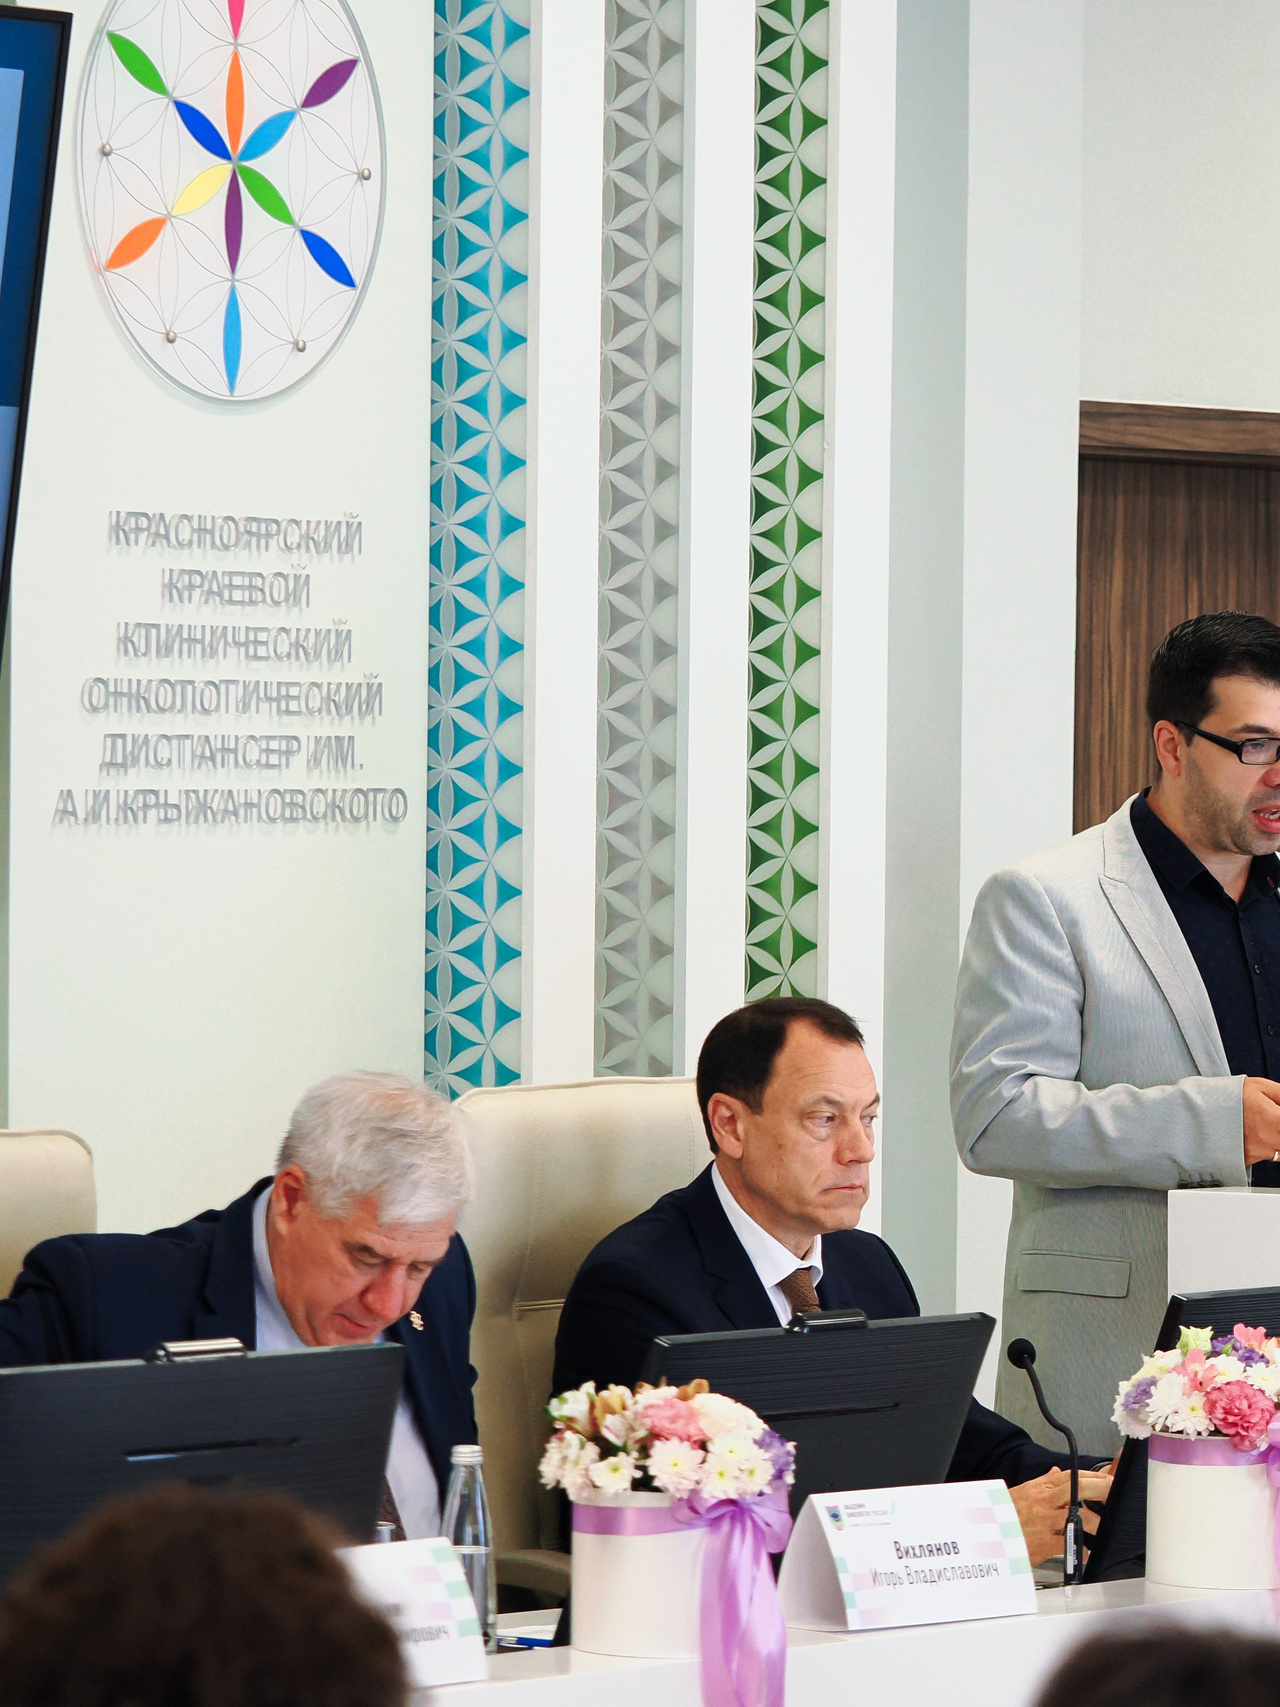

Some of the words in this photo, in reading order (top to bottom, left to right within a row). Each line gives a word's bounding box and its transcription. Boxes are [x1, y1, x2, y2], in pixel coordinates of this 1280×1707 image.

[108, 509, 363, 556] КРАСНОЯРСКИЙ
[161, 562, 311, 608] КРАЕВОЙ
[116, 617, 352, 664] КЛИНИЧЕСКИЙ
[81, 671, 384, 717] ОНКОЛОГИЧЕСКИЙ
[99, 733, 302, 776] ДИСПАНСЕР
[306, 735, 364, 771] ИМ.
[893, 1540, 960, 1560] Вихлянов
[869, 1567, 904, 1590] Игорь
[904, 1562, 1000, 1587] Владиславович
